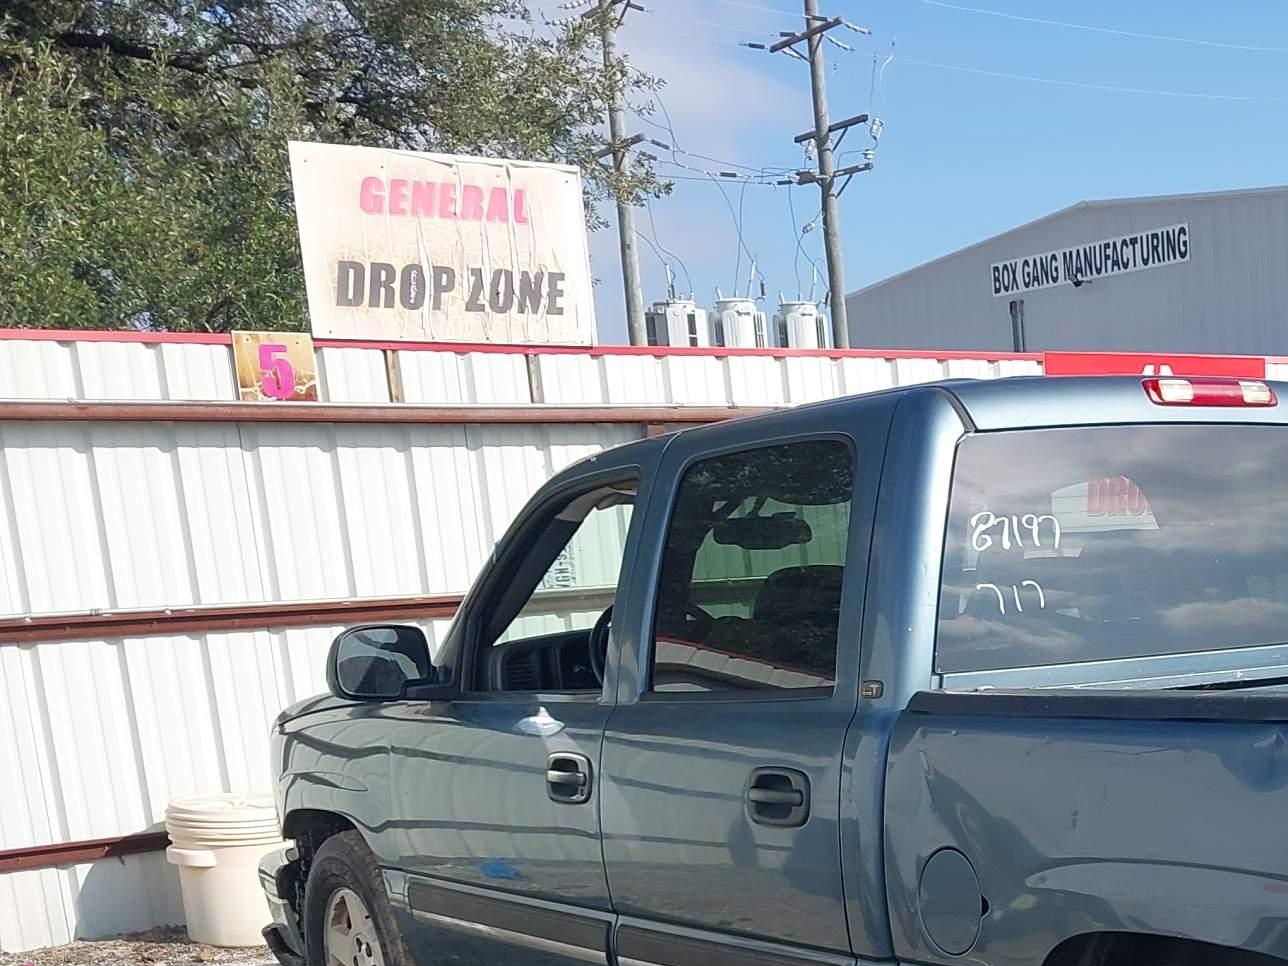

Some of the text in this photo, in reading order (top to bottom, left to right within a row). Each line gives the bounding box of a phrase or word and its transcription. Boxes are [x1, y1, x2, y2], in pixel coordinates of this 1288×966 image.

[359, 176, 528, 224] GENERAL
[335, 260, 566, 316] DROP ZONE
[992, 226, 1189, 296] BOX GANG MANUFACTURING
[258, 344, 295, 400] 5
